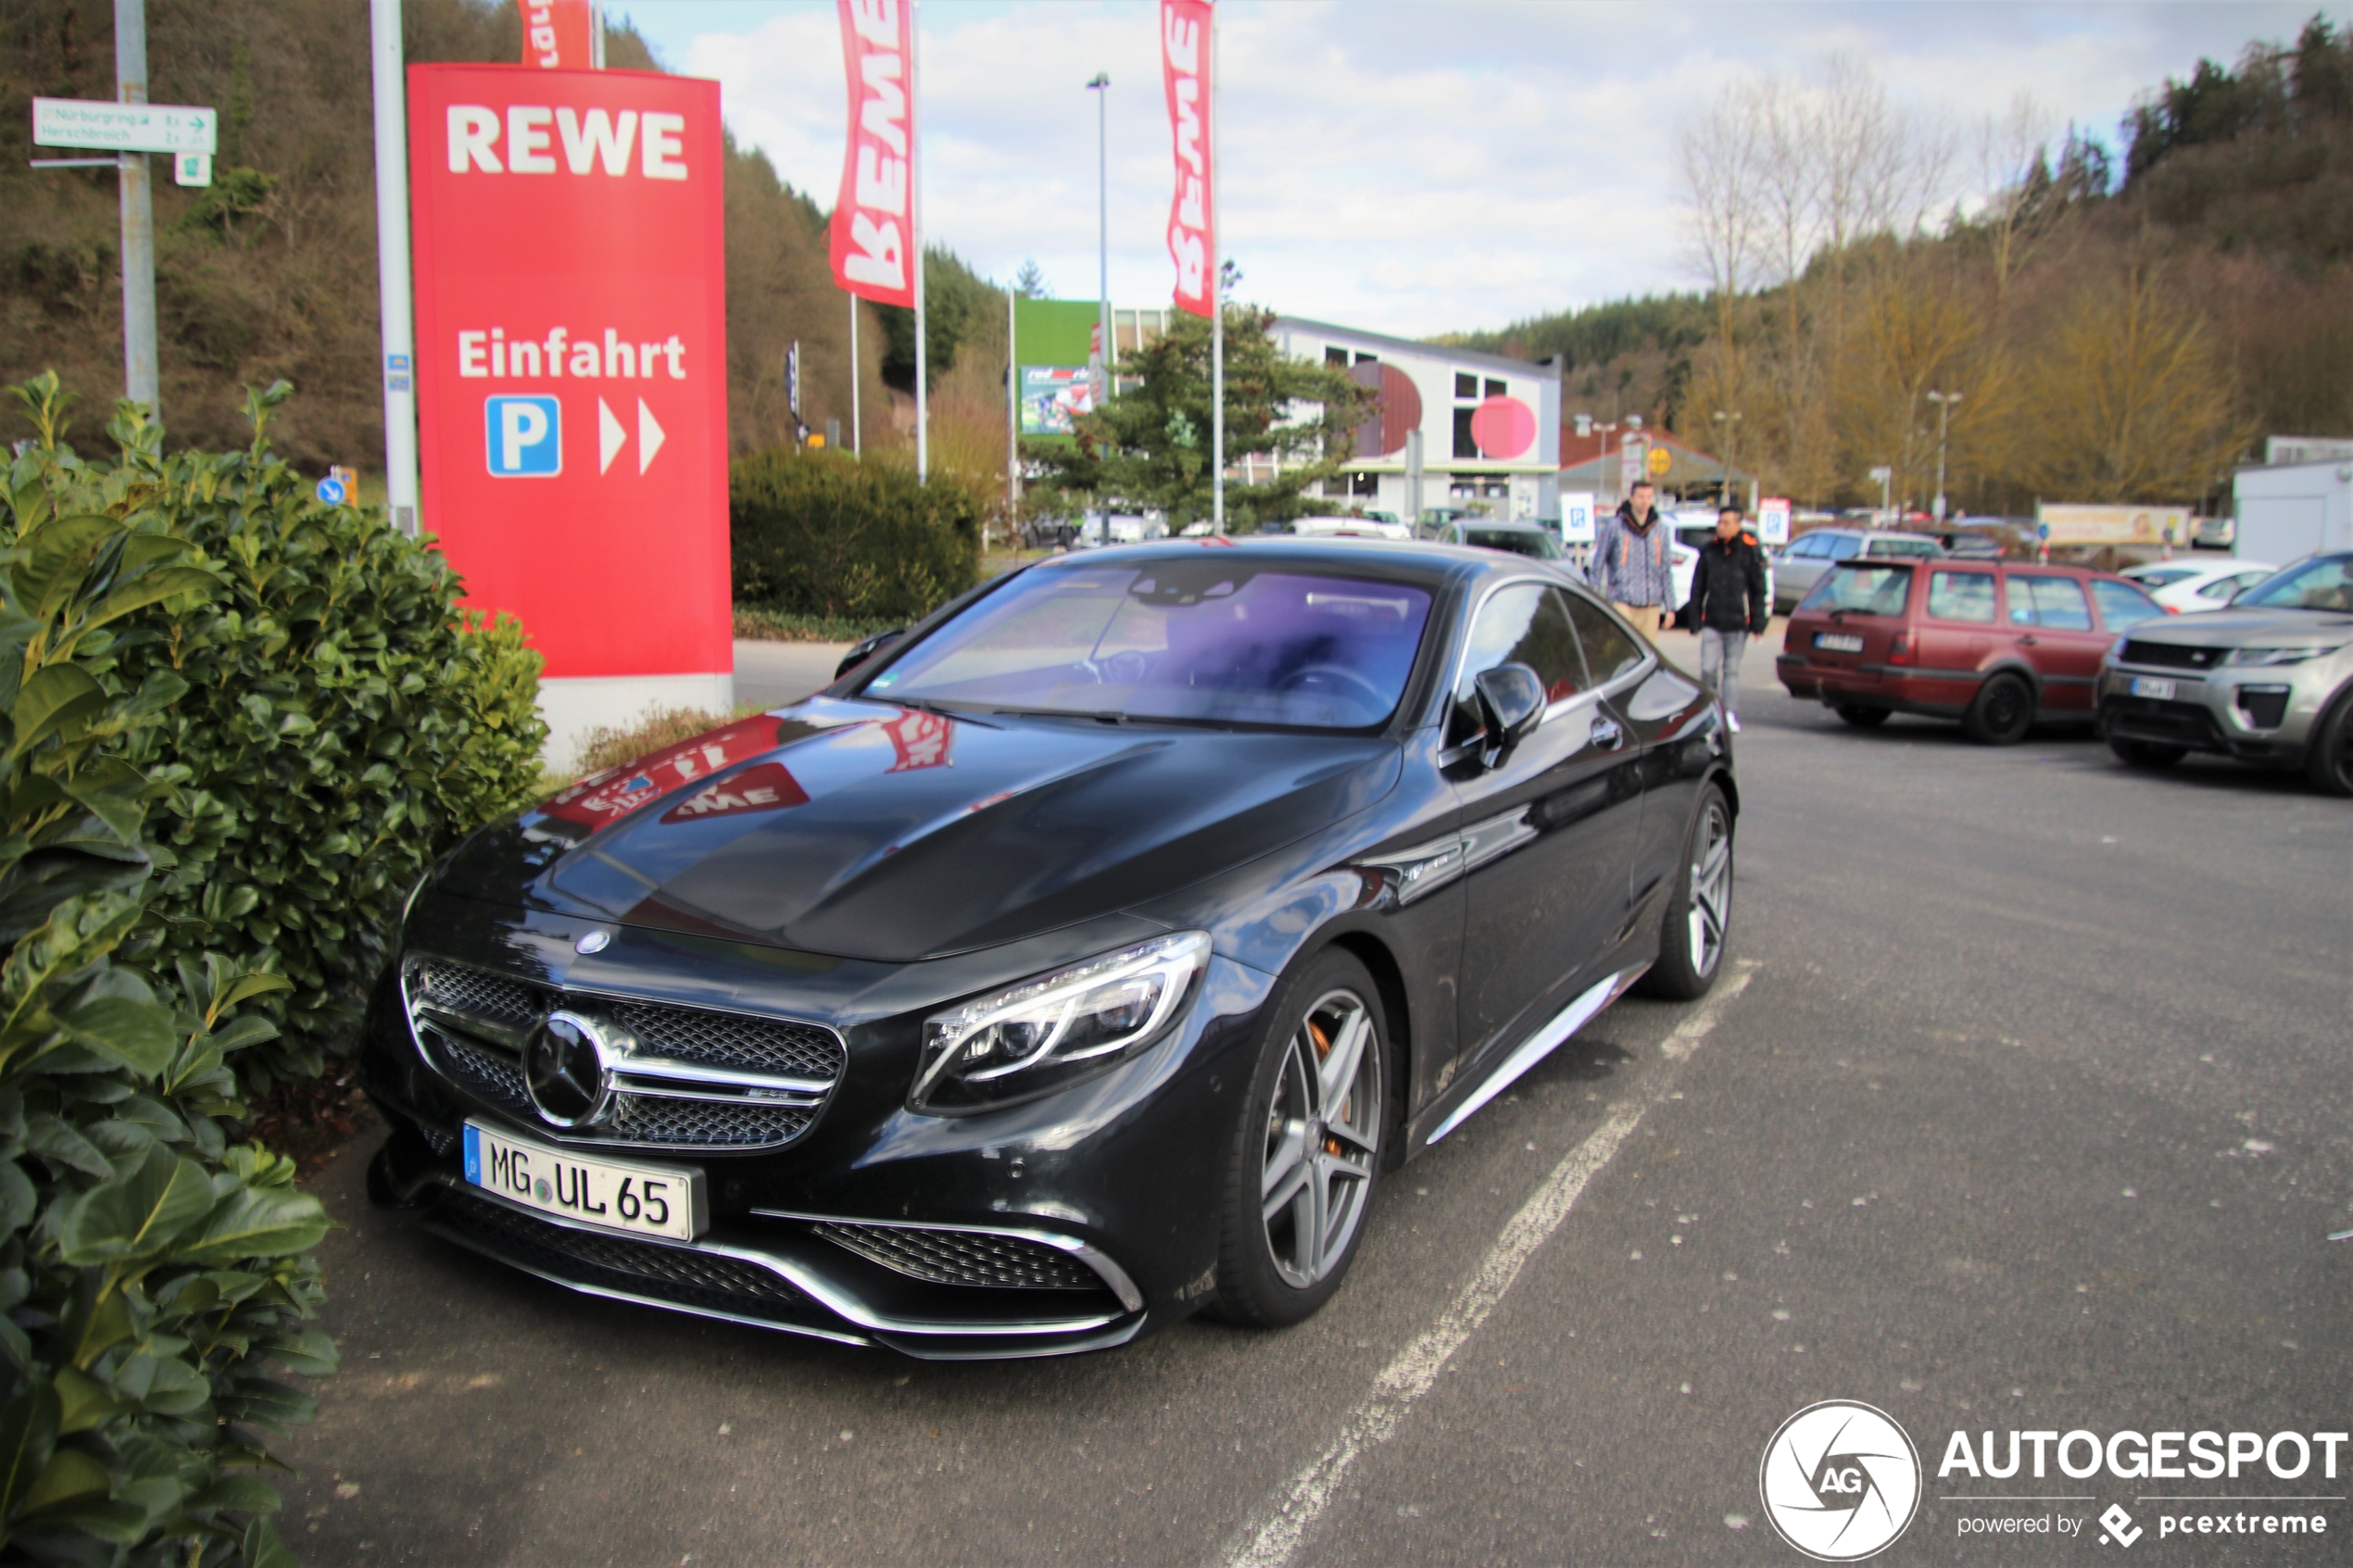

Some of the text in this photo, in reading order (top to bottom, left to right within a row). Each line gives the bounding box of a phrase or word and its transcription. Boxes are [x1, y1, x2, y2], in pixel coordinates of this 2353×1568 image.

[447, 104, 688, 181] REWE
[459, 327, 687, 380] Einfahrt
[501, 402, 548, 470] P
[491, 1142, 532, 1196] MG
[556, 1163, 607, 1215] UL
[617, 1177, 669, 1225] 65
